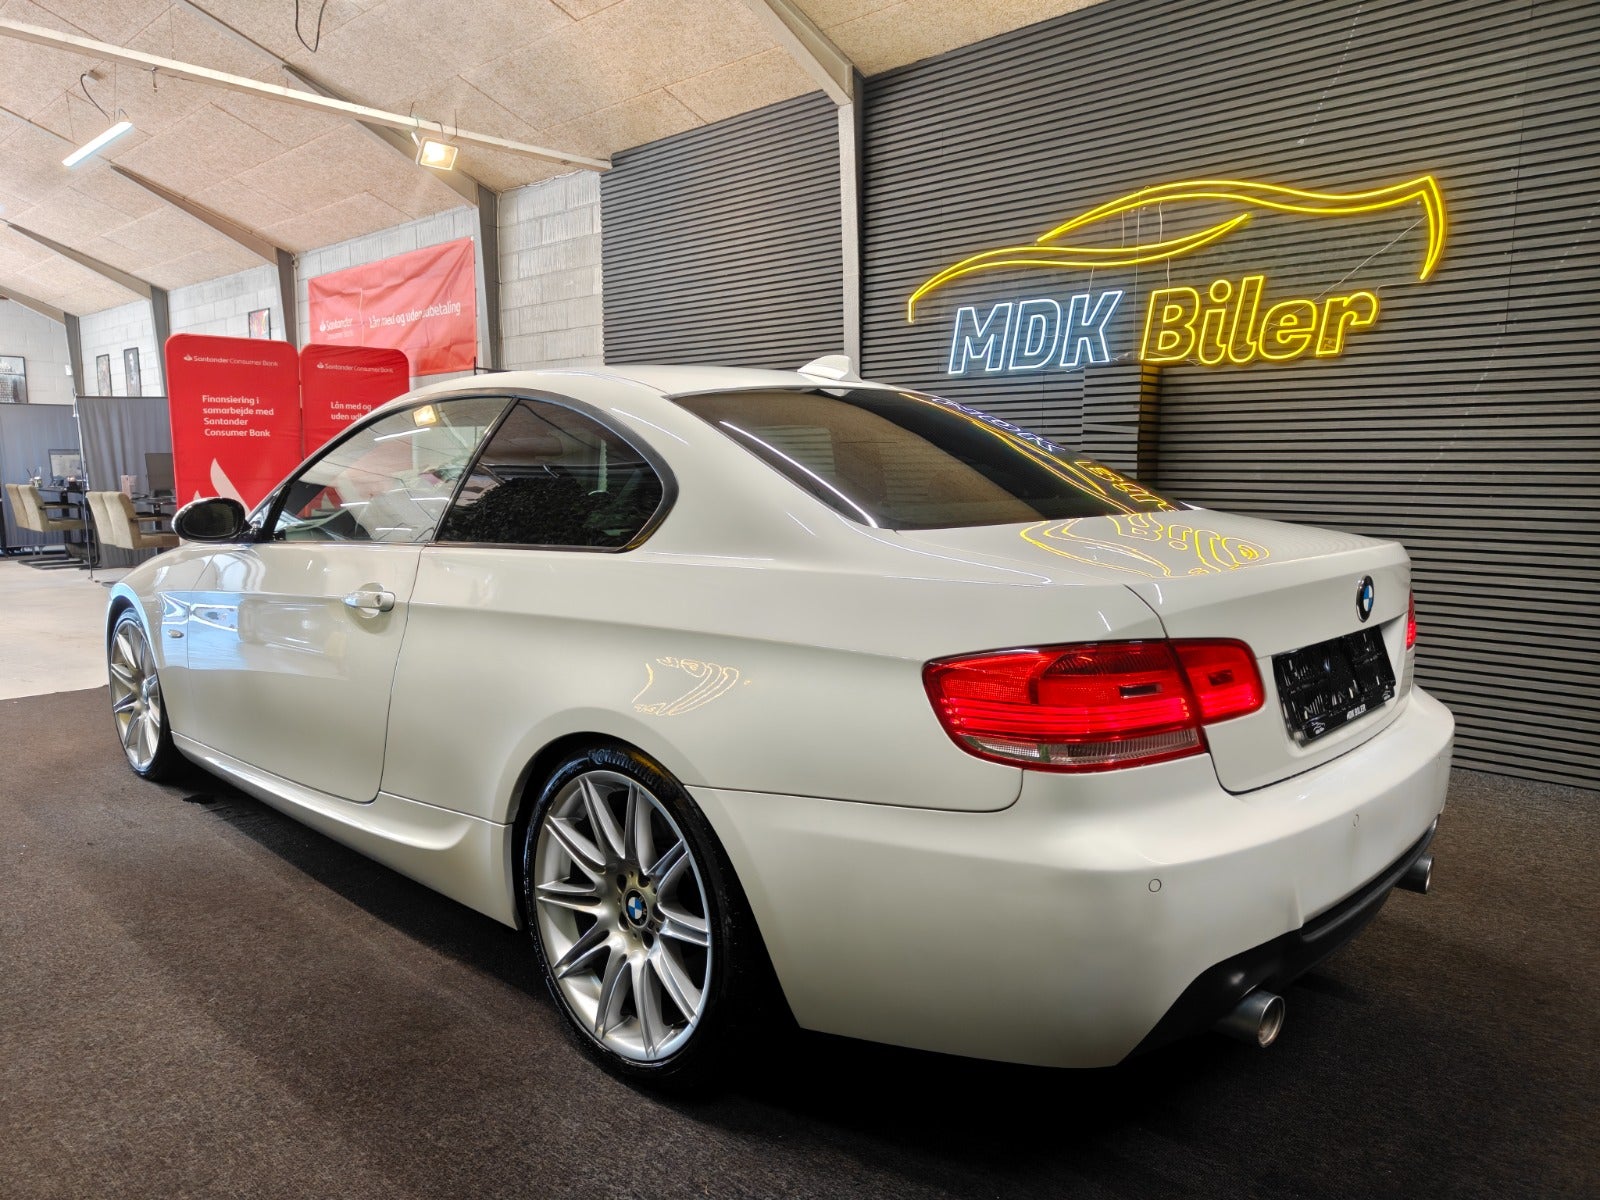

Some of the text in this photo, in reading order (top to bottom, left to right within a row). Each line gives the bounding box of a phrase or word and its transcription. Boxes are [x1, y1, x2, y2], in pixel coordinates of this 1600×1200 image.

[396, 313, 405, 327] og
[948, 275, 1379, 375] MDK Biler
[193, 355, 279, 367] Santander Consumer Bank
[202, 394, 260, 406] Finansiering i
[202, 406, 275, 417] samarbejde med
[330, 401, 372, 412] Lån med og
[203, 417, 248, 426] Santander
[204, 428, 271, 437] Consumer Bank
